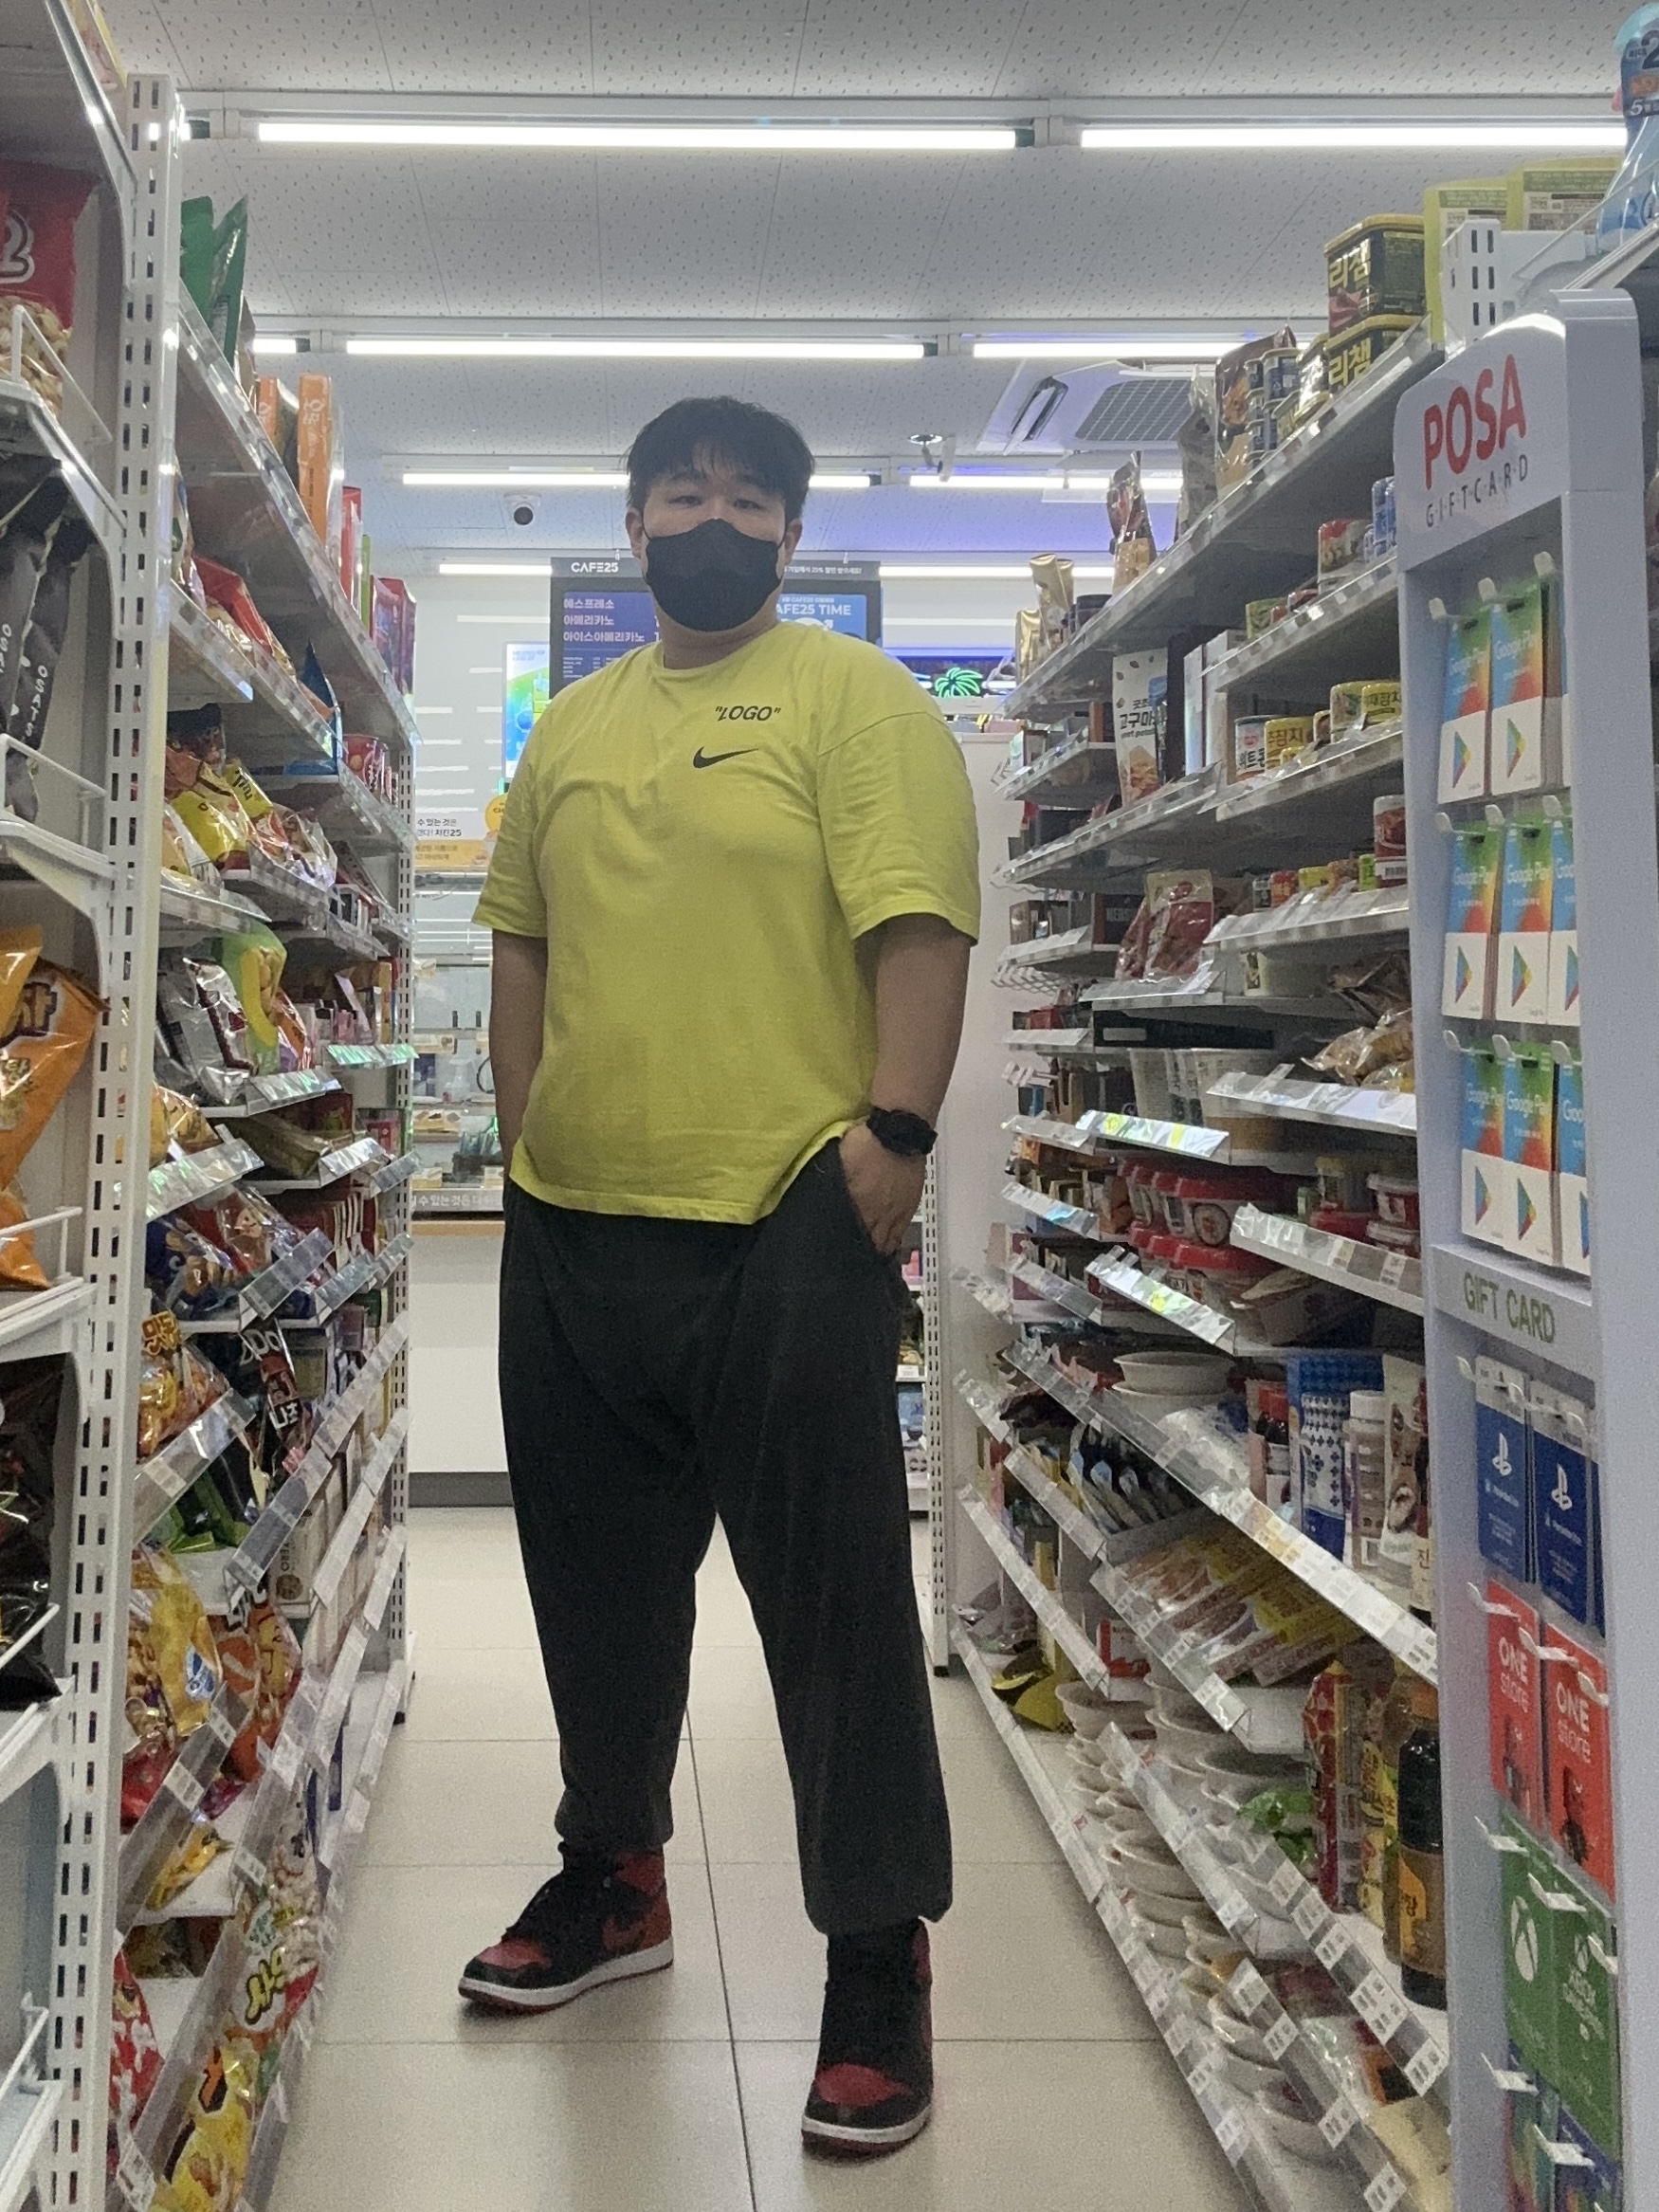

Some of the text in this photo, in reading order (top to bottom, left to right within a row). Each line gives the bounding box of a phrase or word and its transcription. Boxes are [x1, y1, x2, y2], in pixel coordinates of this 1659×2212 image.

[1423, 353, 1526, 491] POSA
[571, 561, 619, 574] CAFE25
[563, 598, 615, 609] 에스프레소
[818, 604, 851, 615] TIME
[563, 614, 615, 626] 아메리카노
[563, 631, 646, 642] 아이스아메리카노
[21, 665, 48, 742] OSATS
[417, 818, 458, 827] 수 있는 것은
[434, 829, 462, 837] 치킨25
[418, 1195, 429, 1207] 수
[429, 1195, 449, 1207] 있는
[1464, 1271, 1556, 1344] GIFT CARD
[1499, 1636, 1528, 1686] ONE
[1501, 1672, 1529, 1713] store
[1556, 1681, 1590, 1733] ONE
[1558, 1718, 1591, 1764] store
